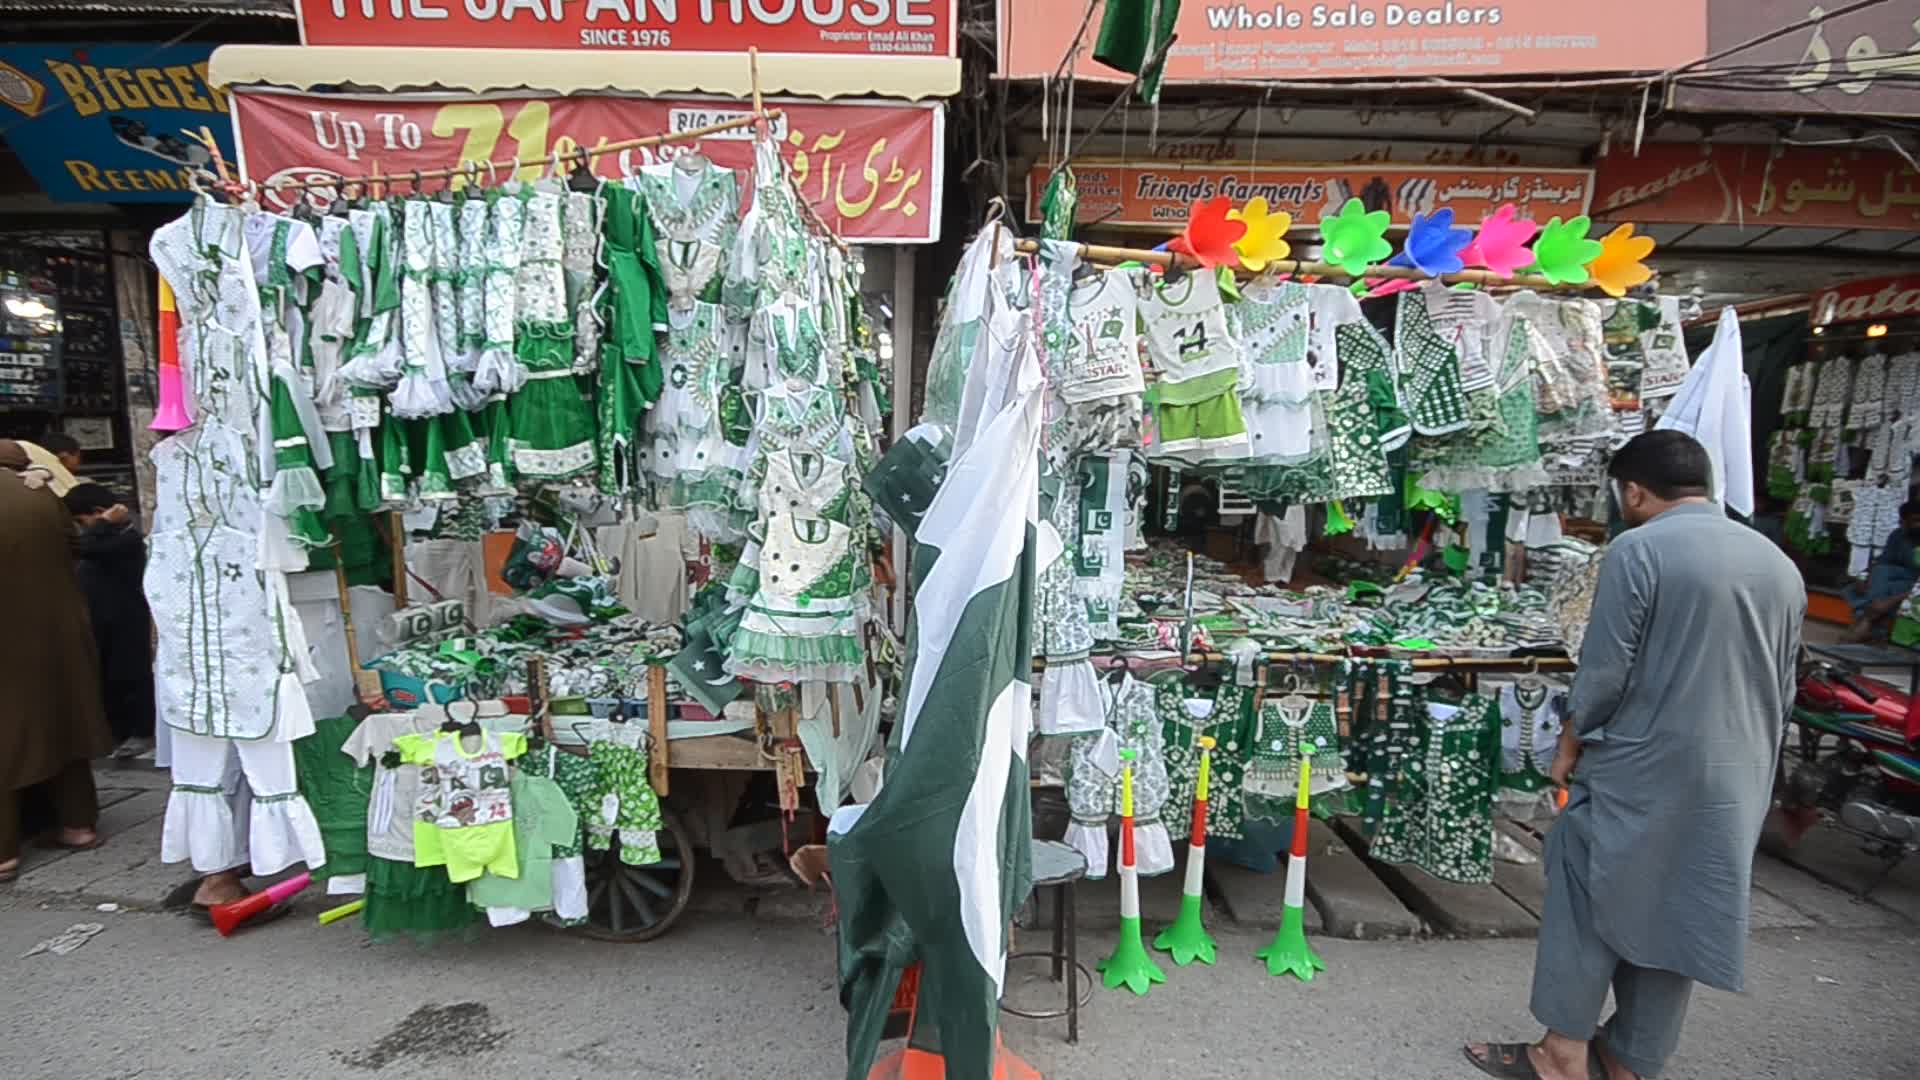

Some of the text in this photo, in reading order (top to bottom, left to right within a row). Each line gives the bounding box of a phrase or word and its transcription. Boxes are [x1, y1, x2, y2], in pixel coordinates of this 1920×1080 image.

[1207, 1, 1501, 29] Whole Sale Dealers
[581, 29, 671, 47] SINCE 1976
[677, 112, 708, 132] BIG
[309, 111, 366, 160] Up
[375, 113, 422, 150] To
[1137, 175, 1324, 204] Friends Garments
[1152, 206, 1190, 218] Whol
